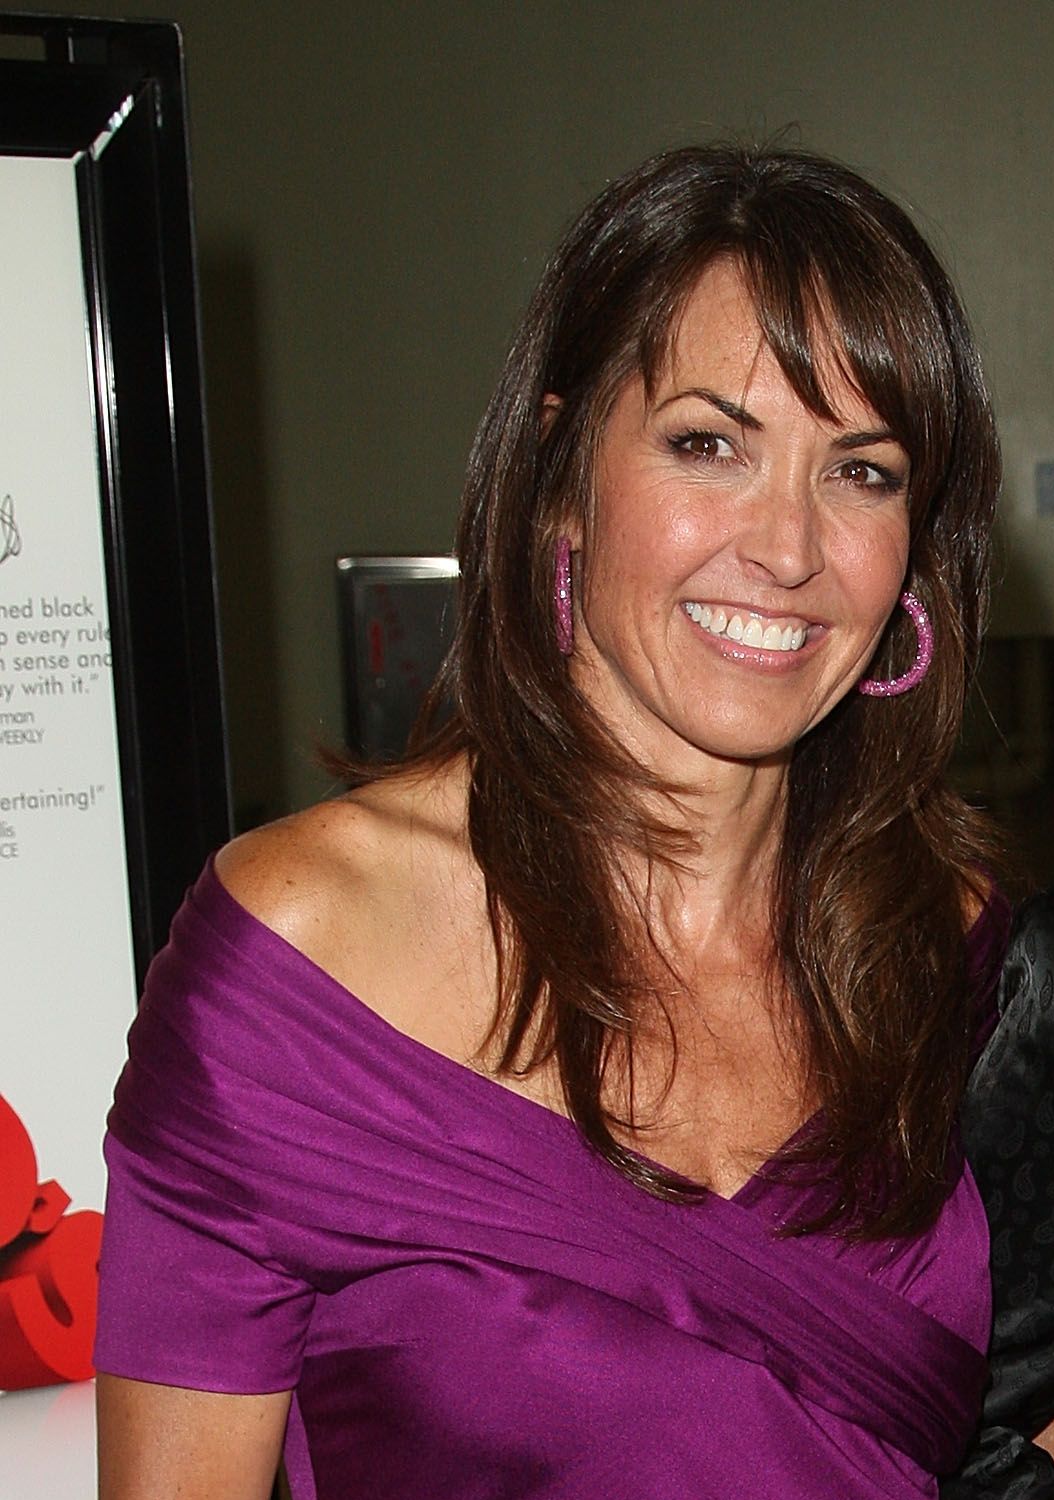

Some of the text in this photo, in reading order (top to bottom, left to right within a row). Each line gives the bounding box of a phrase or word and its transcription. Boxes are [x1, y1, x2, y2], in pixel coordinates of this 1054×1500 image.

[41, 595, 94, 617] black
[16, 629, 70, 648] every
[13, 656, 69, 671] sense
[21, 675, 64, 695] with
